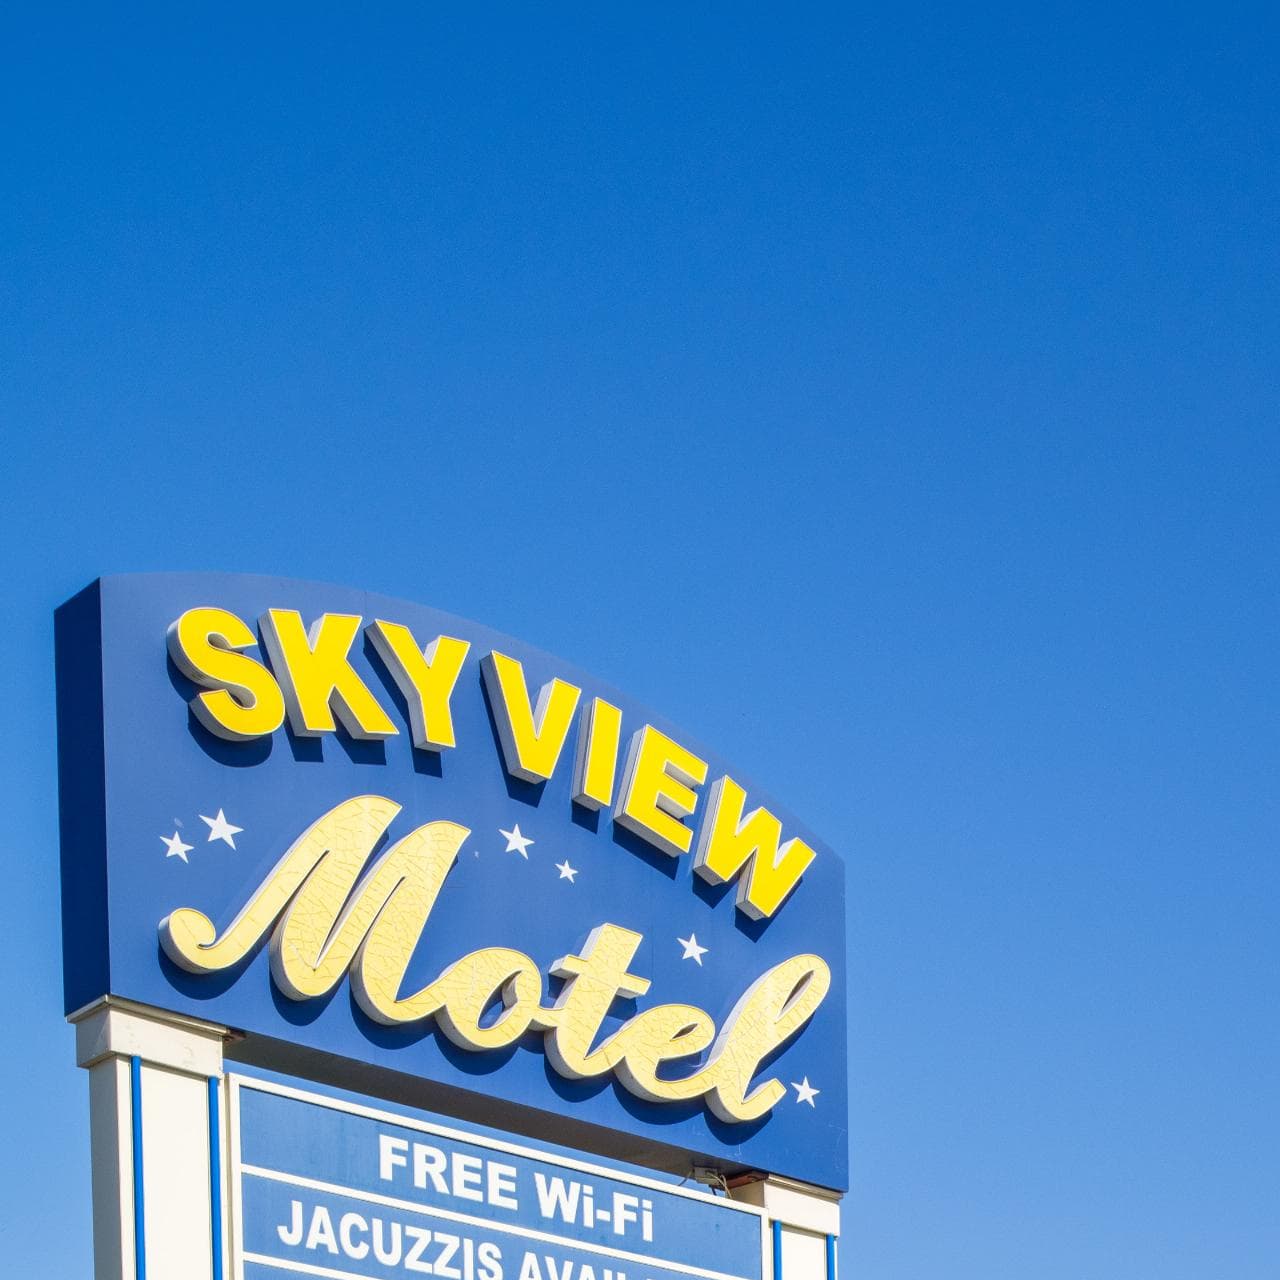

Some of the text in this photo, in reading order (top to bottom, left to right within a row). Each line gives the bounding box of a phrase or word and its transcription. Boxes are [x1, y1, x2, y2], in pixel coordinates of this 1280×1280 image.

[159, 795, 831, 1125] Motel
[379, 1134, 654, 1242] FREE Wi-Fi
